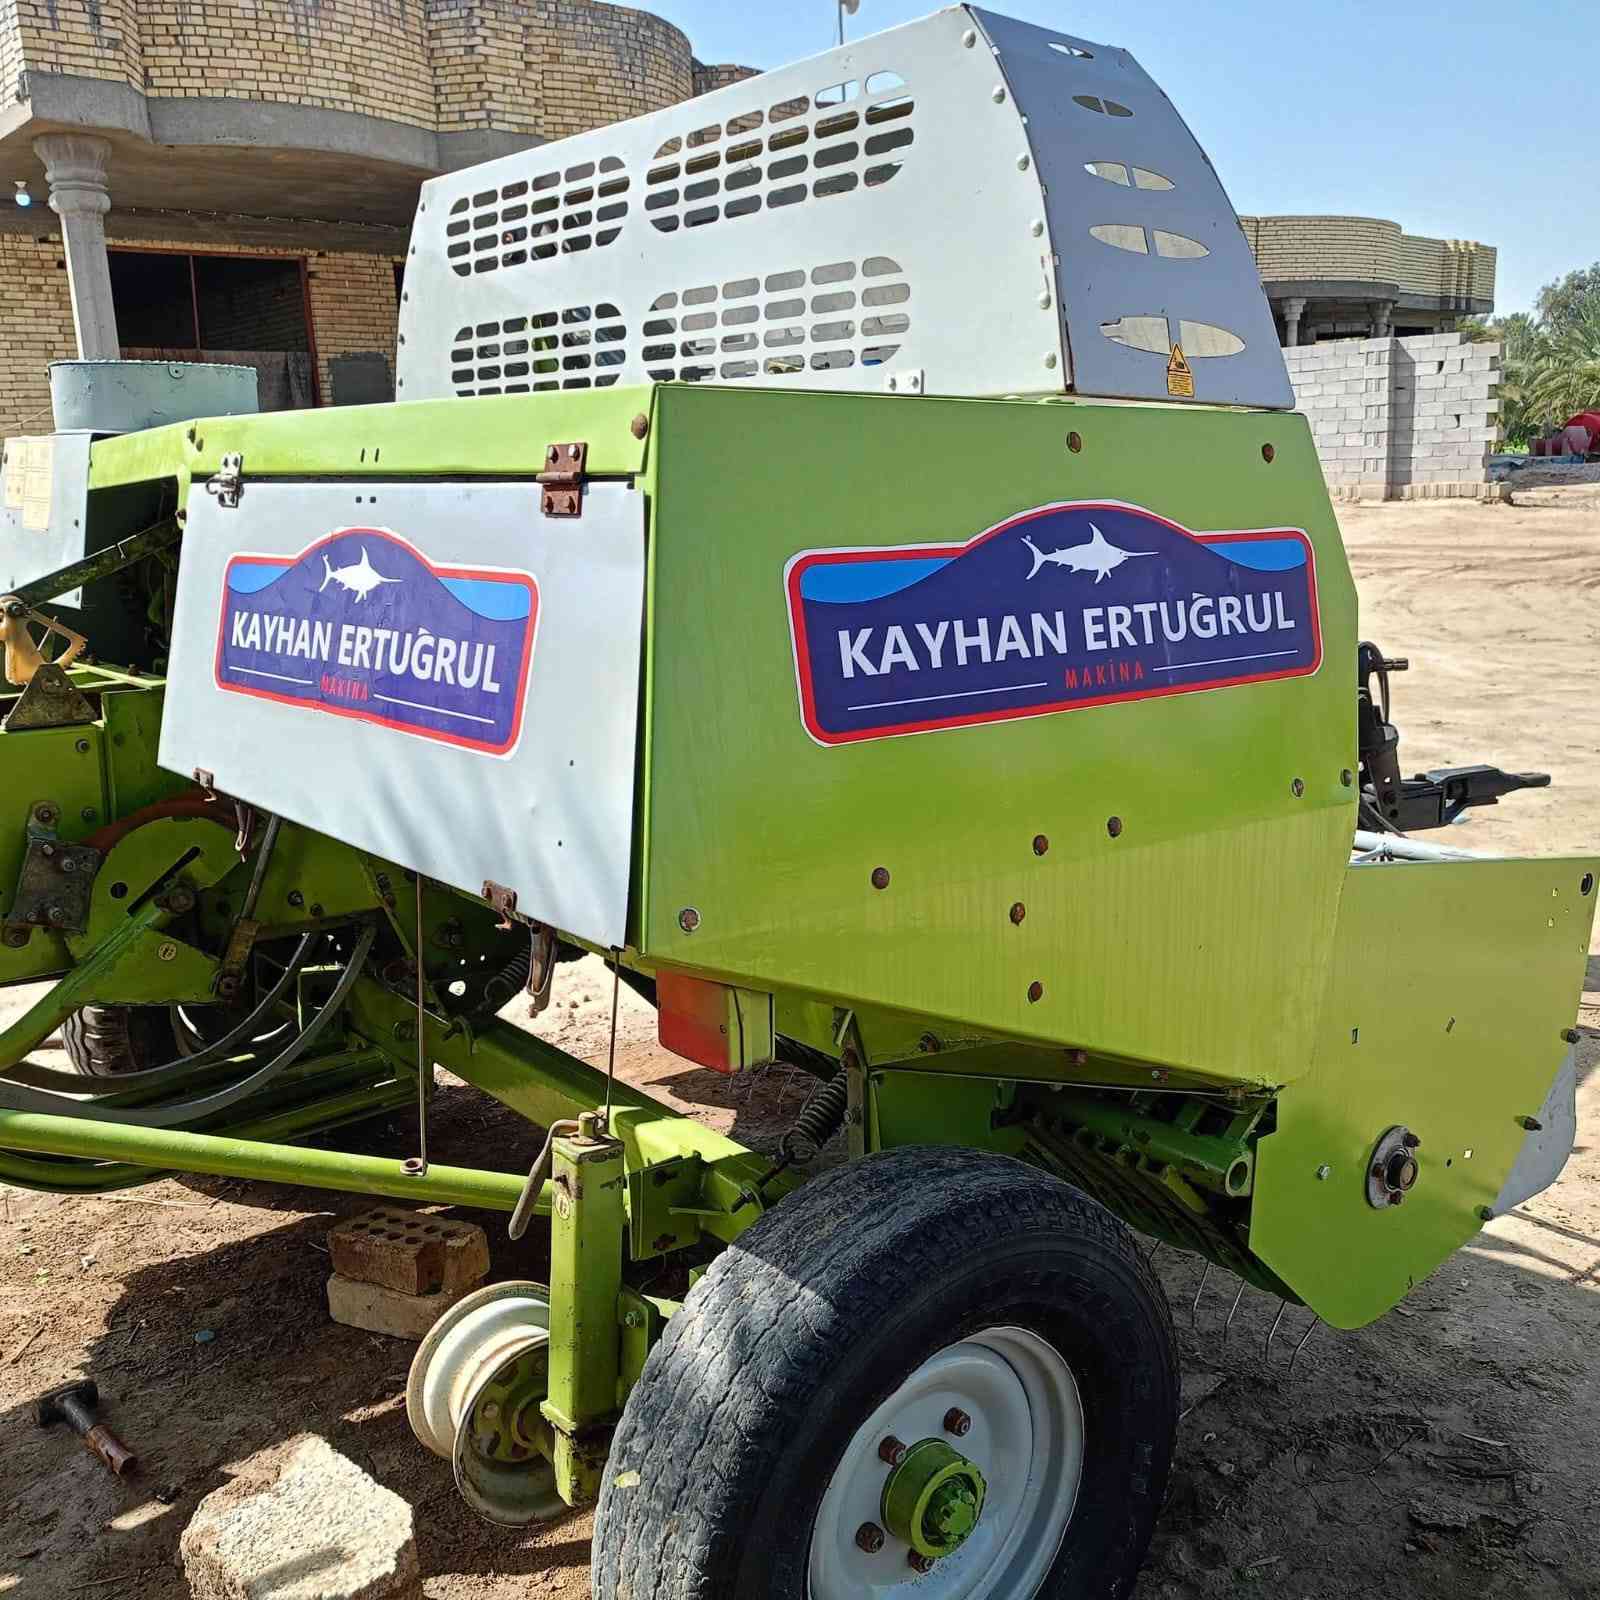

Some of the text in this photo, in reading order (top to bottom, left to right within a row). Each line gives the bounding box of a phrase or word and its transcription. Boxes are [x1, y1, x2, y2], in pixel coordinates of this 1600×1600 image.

[231, 610, 501, 694] KAYHAN ERTUĞRUL
[838, 591, 1296, 679] KAYHAN ERTUĞRUL
